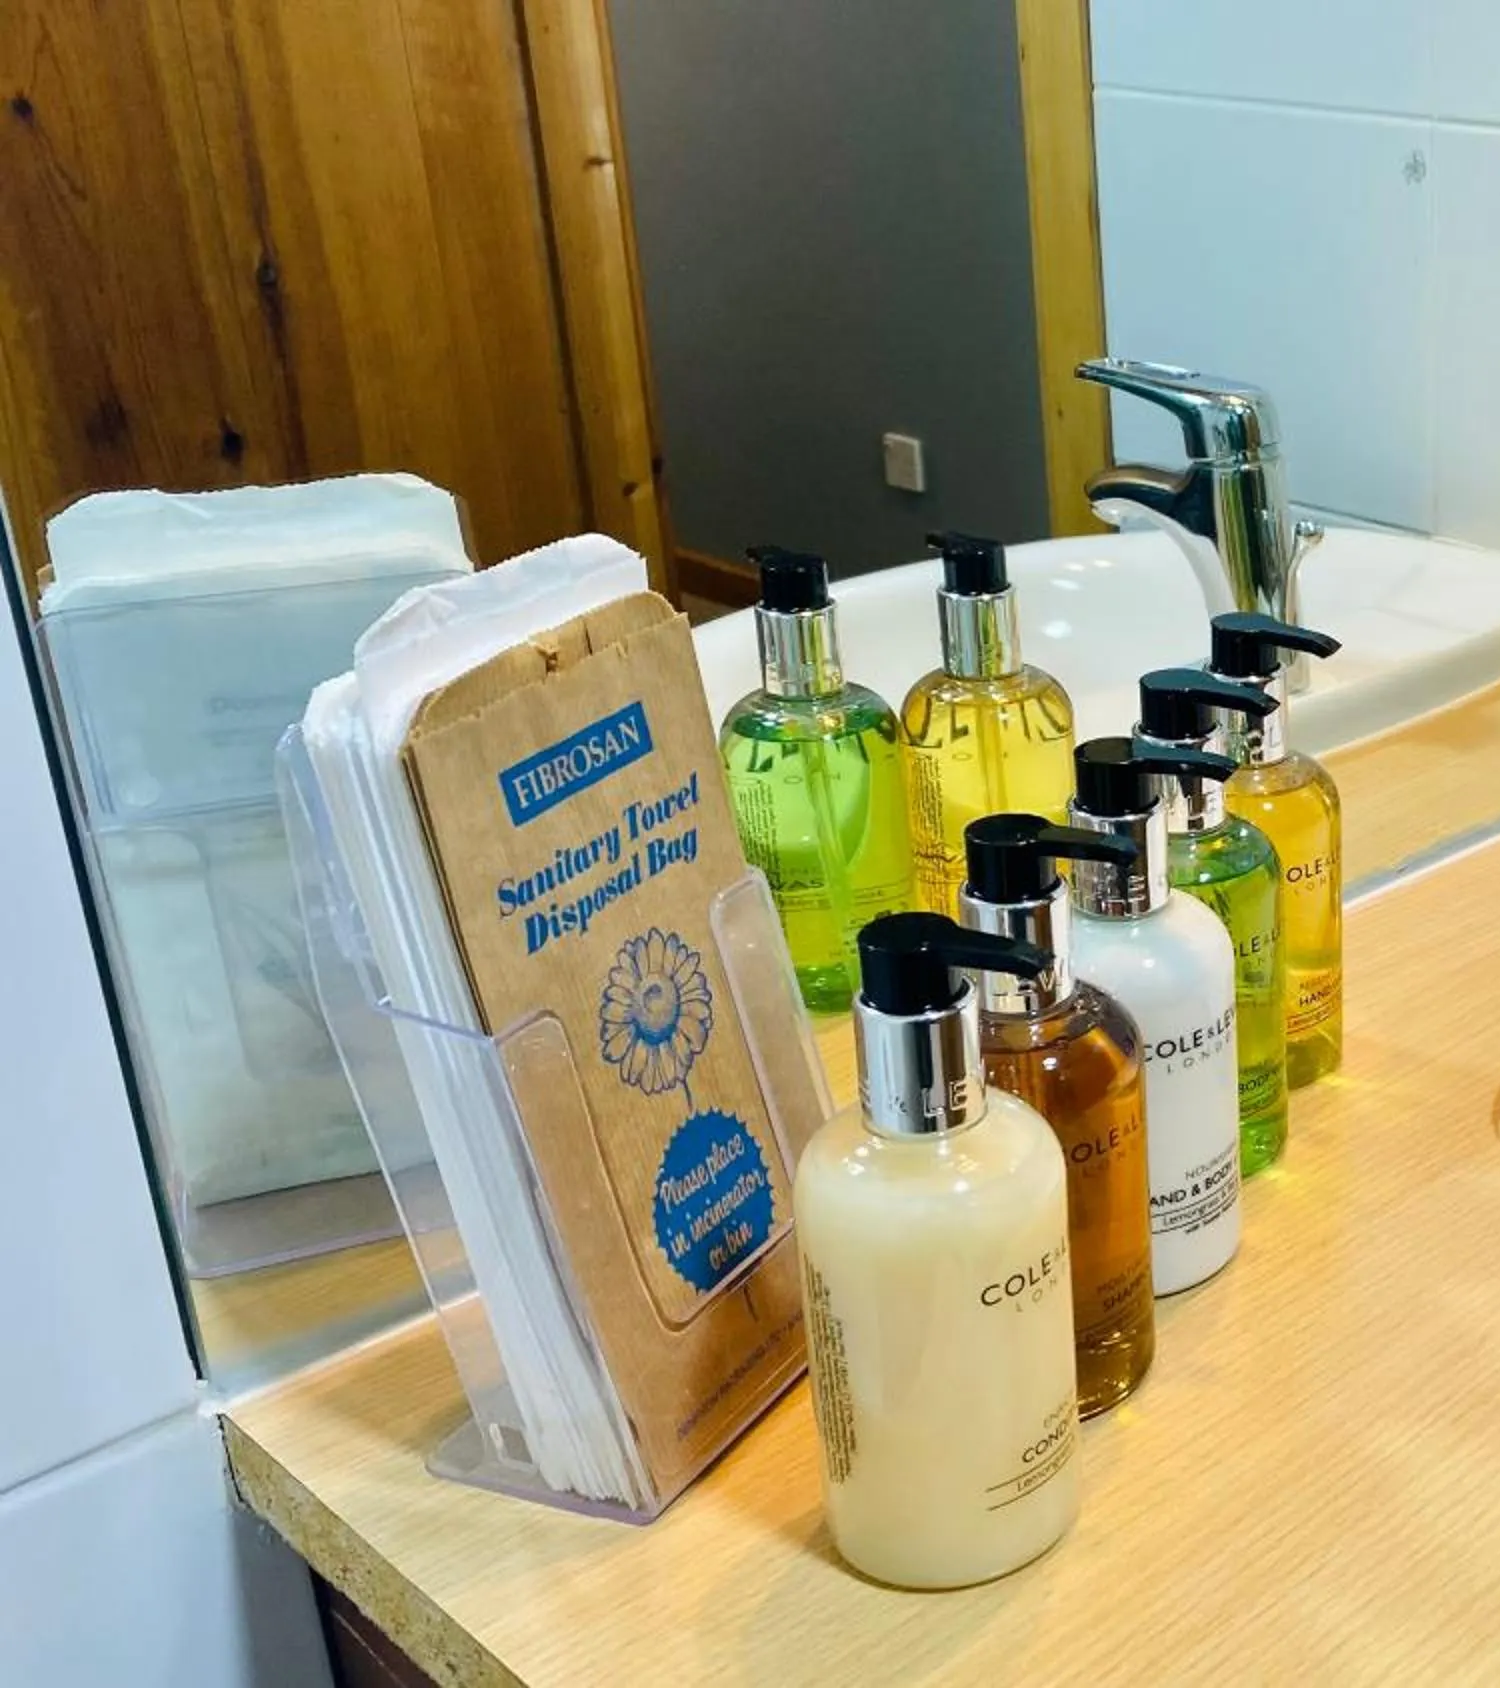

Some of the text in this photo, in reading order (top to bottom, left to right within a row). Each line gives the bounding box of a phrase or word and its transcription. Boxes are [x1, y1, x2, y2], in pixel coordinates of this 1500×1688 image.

[511, 715, 641, 809] FIBROSAN
[498, 825, 621, 918] Sanitary
[624, 771, 698, 841] Towel
[525, 852, 642, 955] Disposal
[647, 827, 697, 877] Bag
[660, 1133, 745, 1214] Please place
[667, 1169, 765, 1259] in incinerator
[1149, 1189, 1187, 1208] AND
[709, 1220, 753, 1271] or bin
